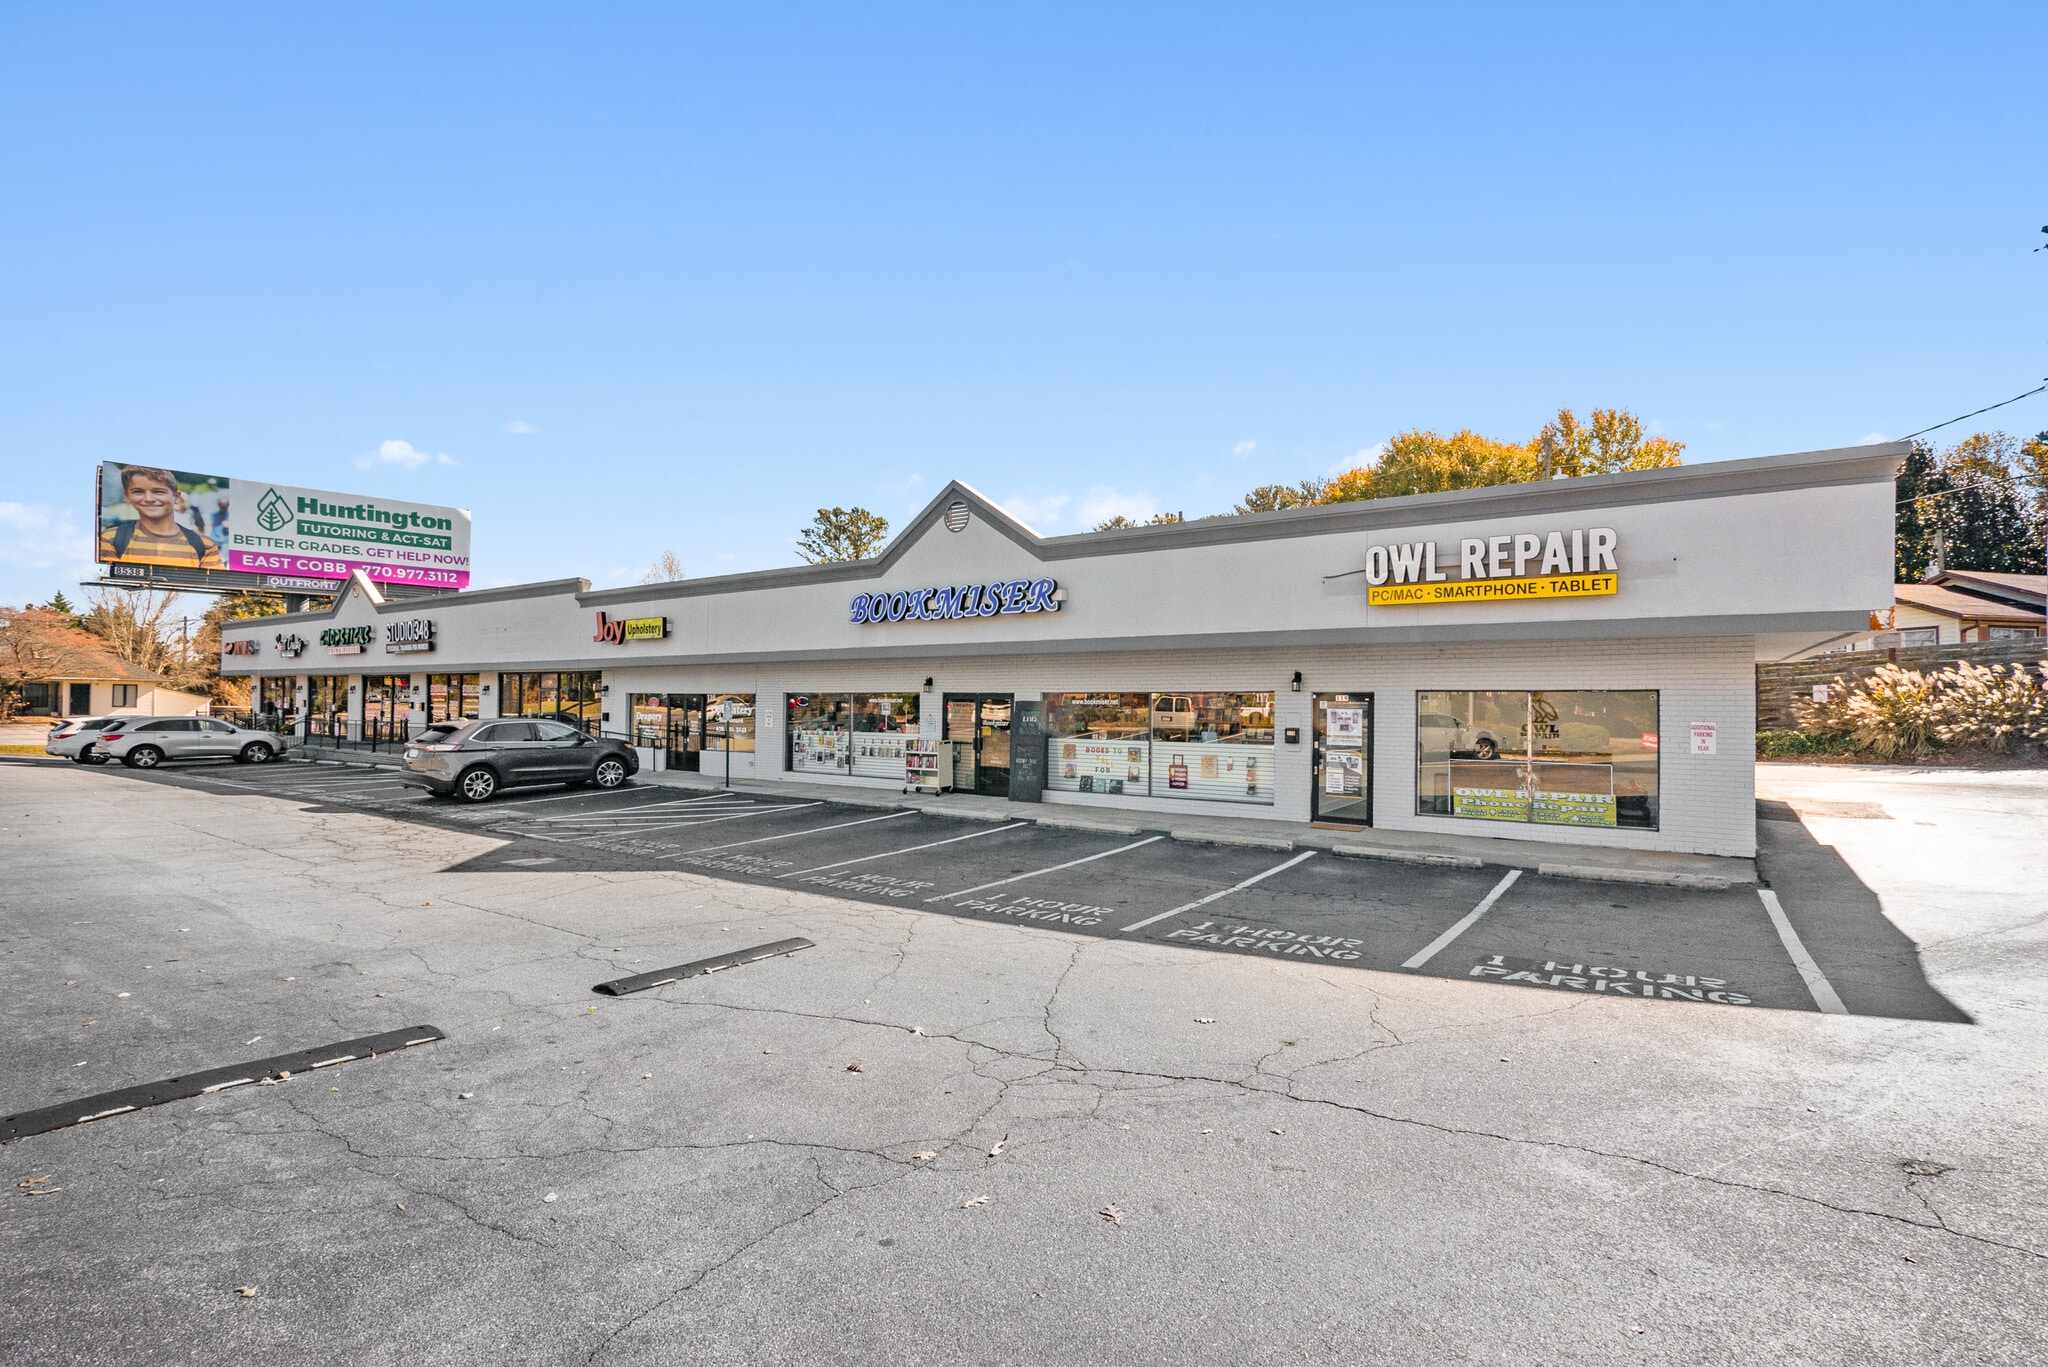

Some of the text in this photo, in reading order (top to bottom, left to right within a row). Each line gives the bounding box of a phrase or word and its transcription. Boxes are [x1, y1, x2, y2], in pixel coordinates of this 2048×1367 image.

[296, 496, 452, 531] Huntington
[301, 522, 448, 548] TUTORING & ACT-SAT
[233, 534, 469, 566] BETTER GRADES. GET HELP NOW!
[1365, 526, 1619, 586] OWL REPAIR
[242, 554, 458, 583] EAST COBB 770.977.3112
[269, 577, 337, 589] OUTFRONT
[1371, 578, 1613, 602] PC/MAC SMARTPHONE TABLET
[849, 578, 1058, 625] BOOKMISER
[593, 611, 627, 645] Joy
[627, 623, 662, 636] Upholstery
[1085, 746, 1109, 754] BOOKS
[1095, 766, 1111, 774] FOR
[1455, 788, 1614, 804] OWL REPAIR
[1533, 802, 1607, 813] Repair
[798, 875, 916, 898] PARKING
[850, 873, 935, 890] HOUR
[954, 899, 1103, 927] PARKING
[1011, 897, 1114, 916] HOUR
[1166, 929, 1364, 960] PARKING
[1192, 921, 1365, 948] 1 HOUR
[1468, 965, 1752, 1005] PARKING
[1490, 955, 1727, 989] 1 HOUR
